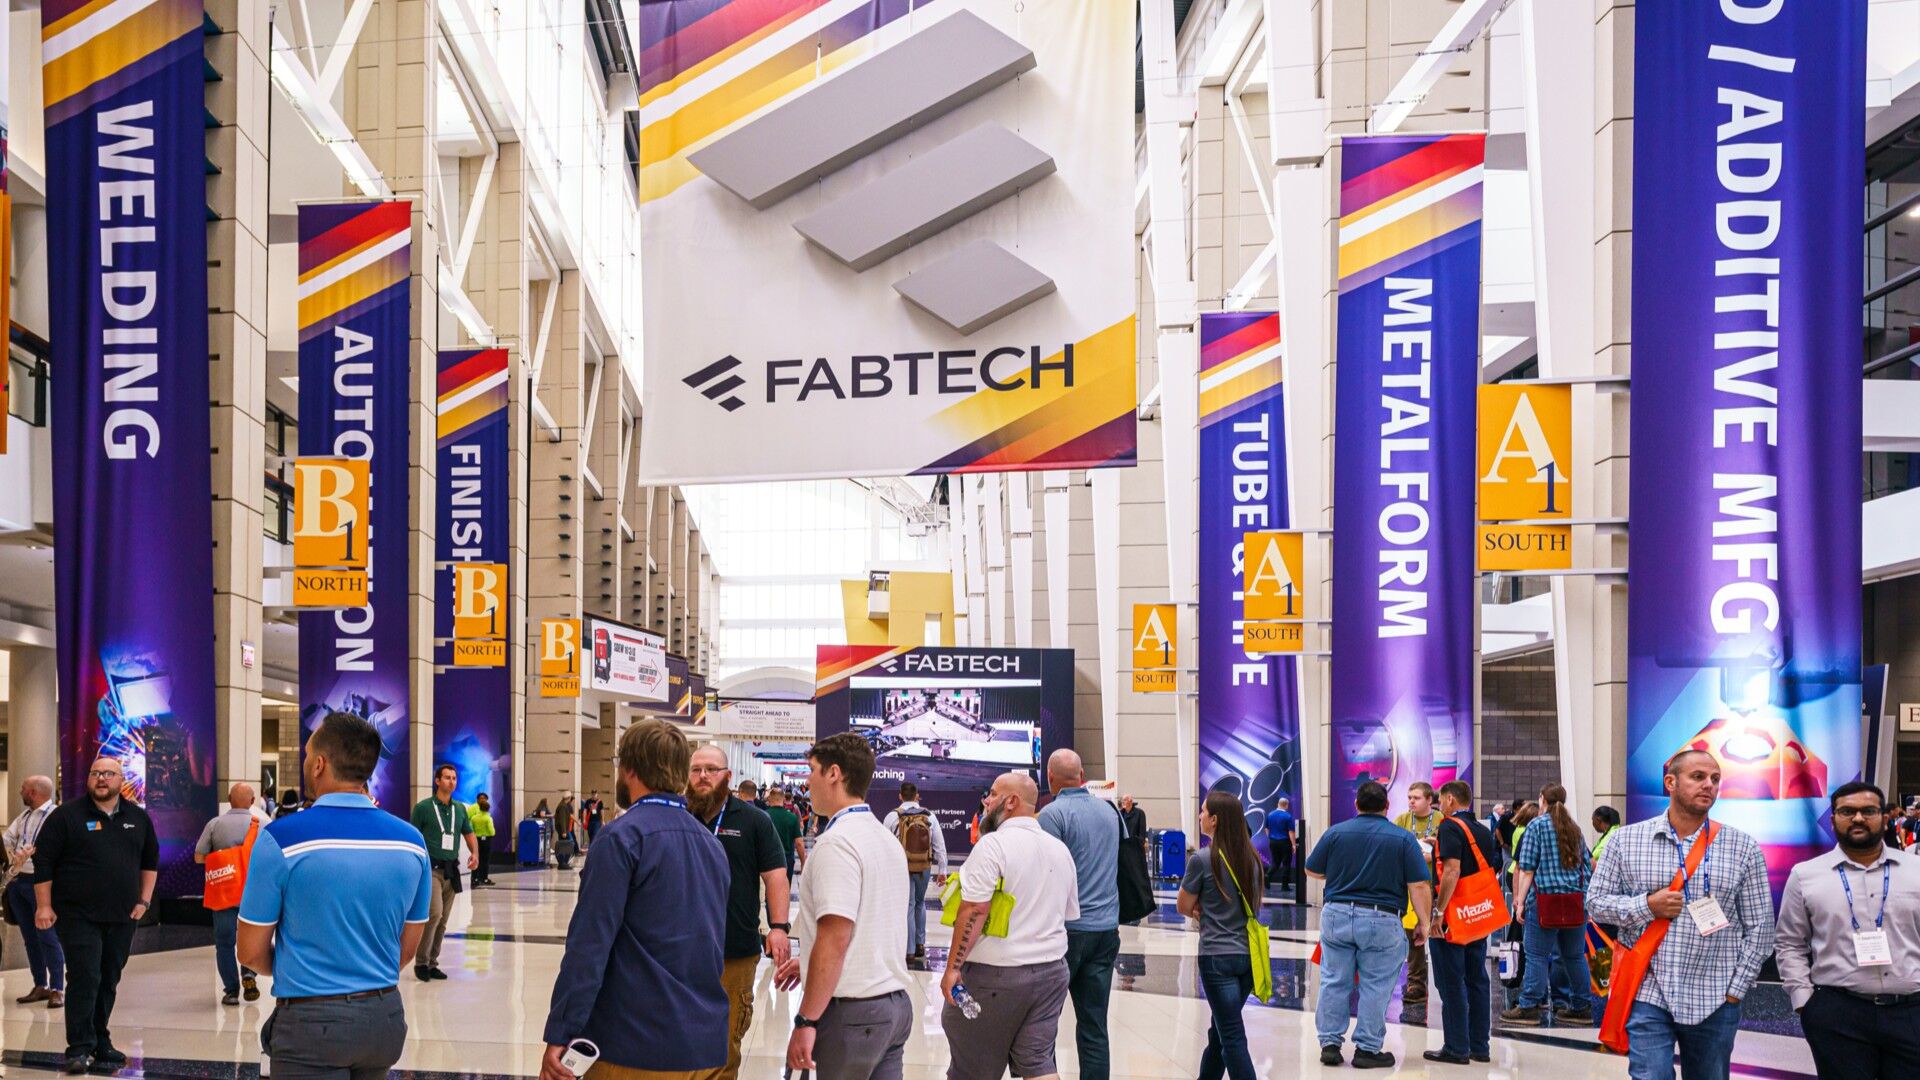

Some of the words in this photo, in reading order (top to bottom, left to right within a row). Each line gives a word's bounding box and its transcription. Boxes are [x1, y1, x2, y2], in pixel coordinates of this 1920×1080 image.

[1713, 87, 1783, 448] ADDITIVE
[97, 100, 160, 460] WELDING
[766, 343, 1074, 403] FABTECH
[1378, 277, 1433, 638] METALFORM
[1232, 413, 1269, 528] TUBE
[333, 325, 374, 672] AUTOON
[1485, 533, 1568, 552] SOUTH
[1709, 473, 1780, 634] MFG
[296, 576, 363, 592] NORTH
[1247, 628, 1300, 641] SOUTH
[457, 644, 503, 657] NORTH
[904, 654, 1020, 673] FABTECH
[542, 681, 578, 691] NORTH
[1135, 674, 1175, 684] SOUTH
[872, 769, 905, 781] nching
[205, 864, 236, 881] Mazak
[1456, 899, 1494, 919] Mazak
